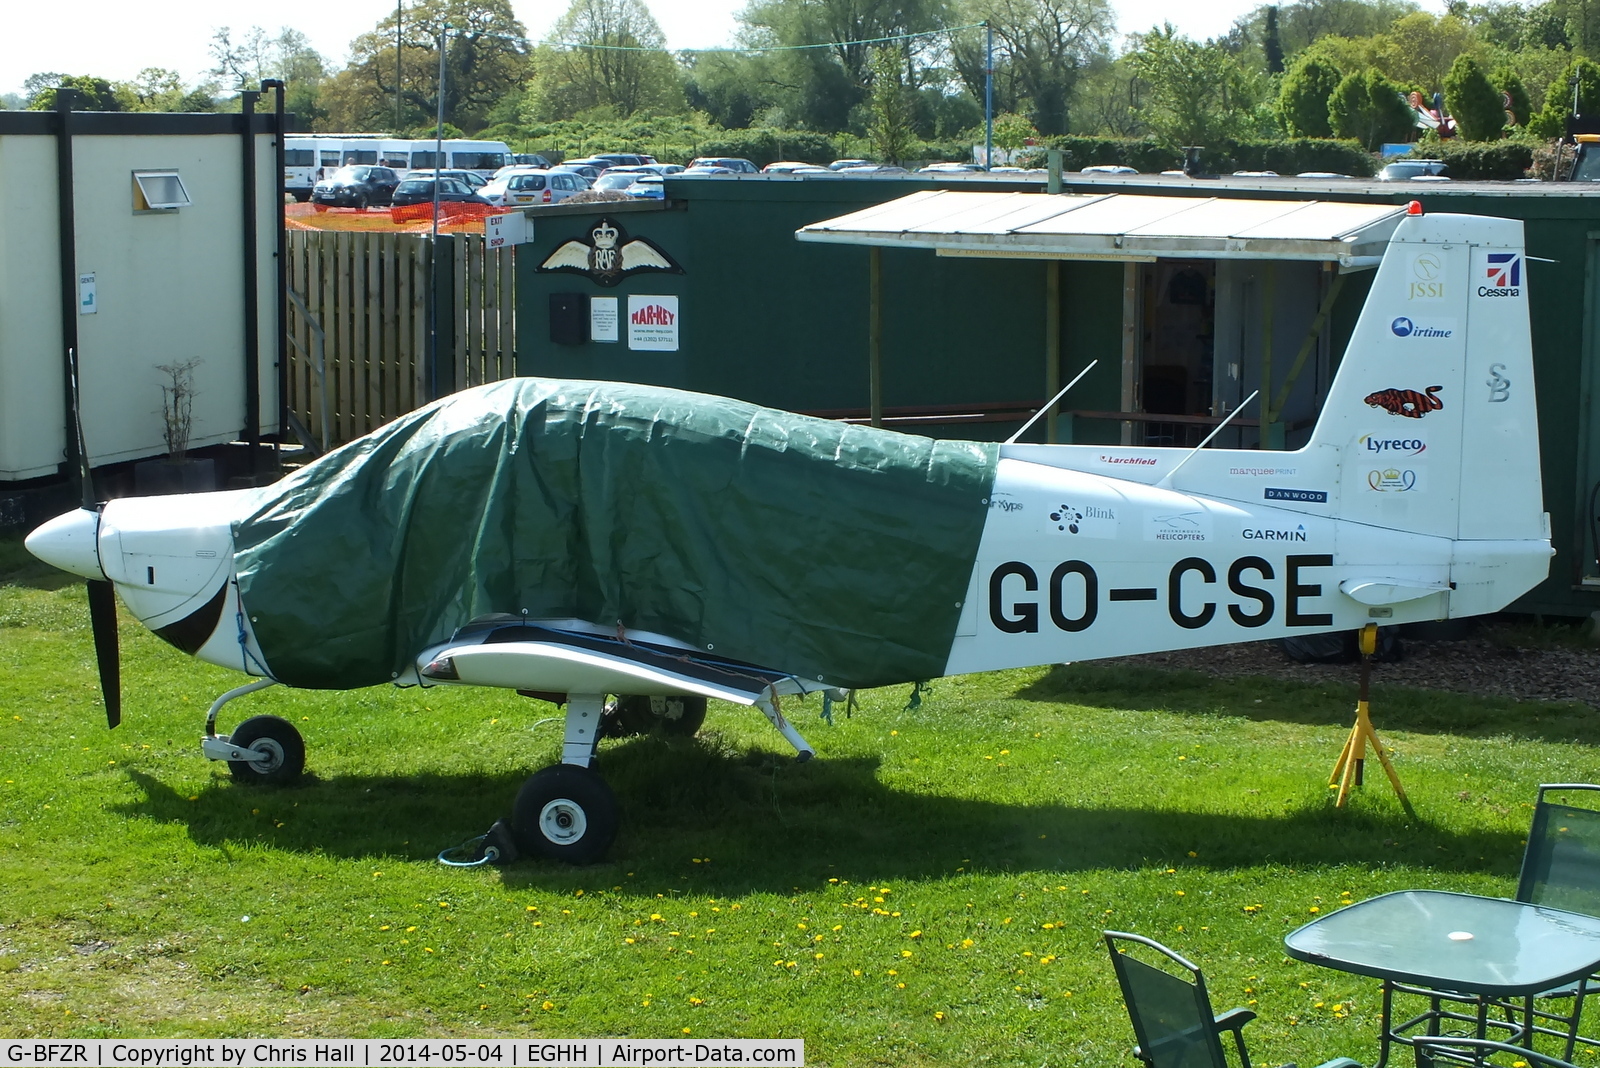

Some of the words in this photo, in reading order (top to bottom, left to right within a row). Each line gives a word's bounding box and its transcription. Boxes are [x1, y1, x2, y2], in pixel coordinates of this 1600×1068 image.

[491, 217, 503, 226] EXIT
[491, 238, 505, 247] SHOP
[1408, 282, 1443, 300] JSSI
[1478, 286, 1520, 298] Cessna
[632, 304, 675, 325] MAR-KEY
[1367, 437, 1422, 453] Lyreco
[1108, 456, 1158, 466] Larchfield
[1268, 490, 1323, 500] DANWOOD
[1085, 506, 1115, 520] Blink
[1156, 533, 1205, 542] HELICOPTERS
[1242, 528, 1306, 542] GARMIN
[989, 554, 1334, 634] GO-CSE
